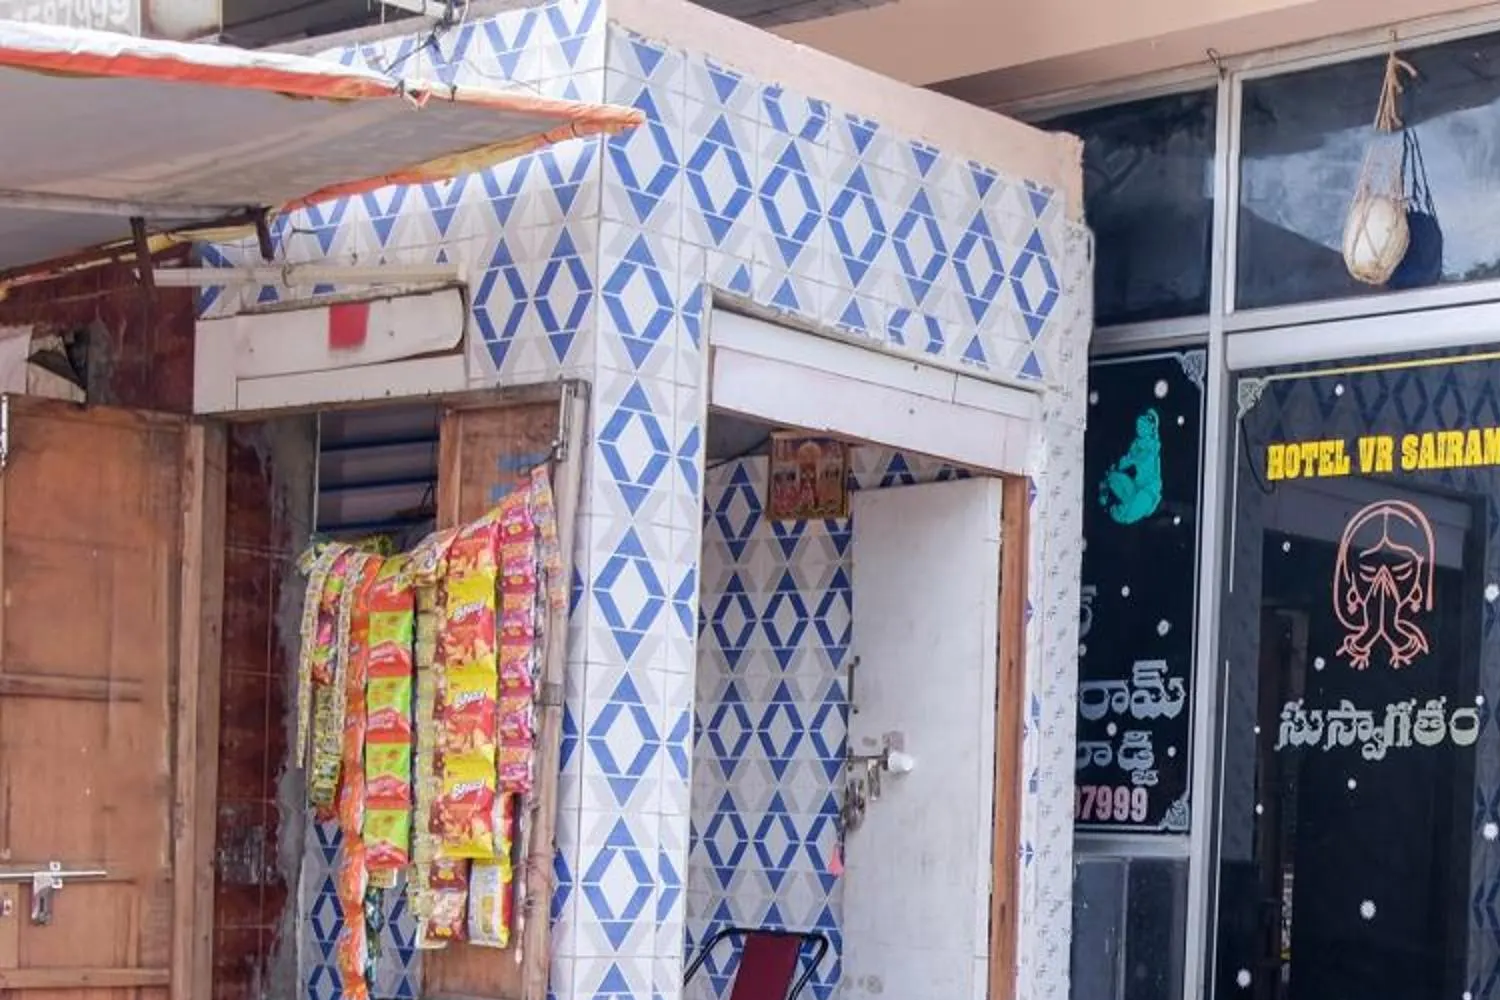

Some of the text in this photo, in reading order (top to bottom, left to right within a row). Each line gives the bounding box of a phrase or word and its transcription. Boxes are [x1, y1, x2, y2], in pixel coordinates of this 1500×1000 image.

[1267, 439, 1350, 480] HOTEL
[1358, 435, 1394, 473] VR
[1273, 696, 1479, 760] సుస్వాగతం
[1074, 785, 1149, 823] 7999
